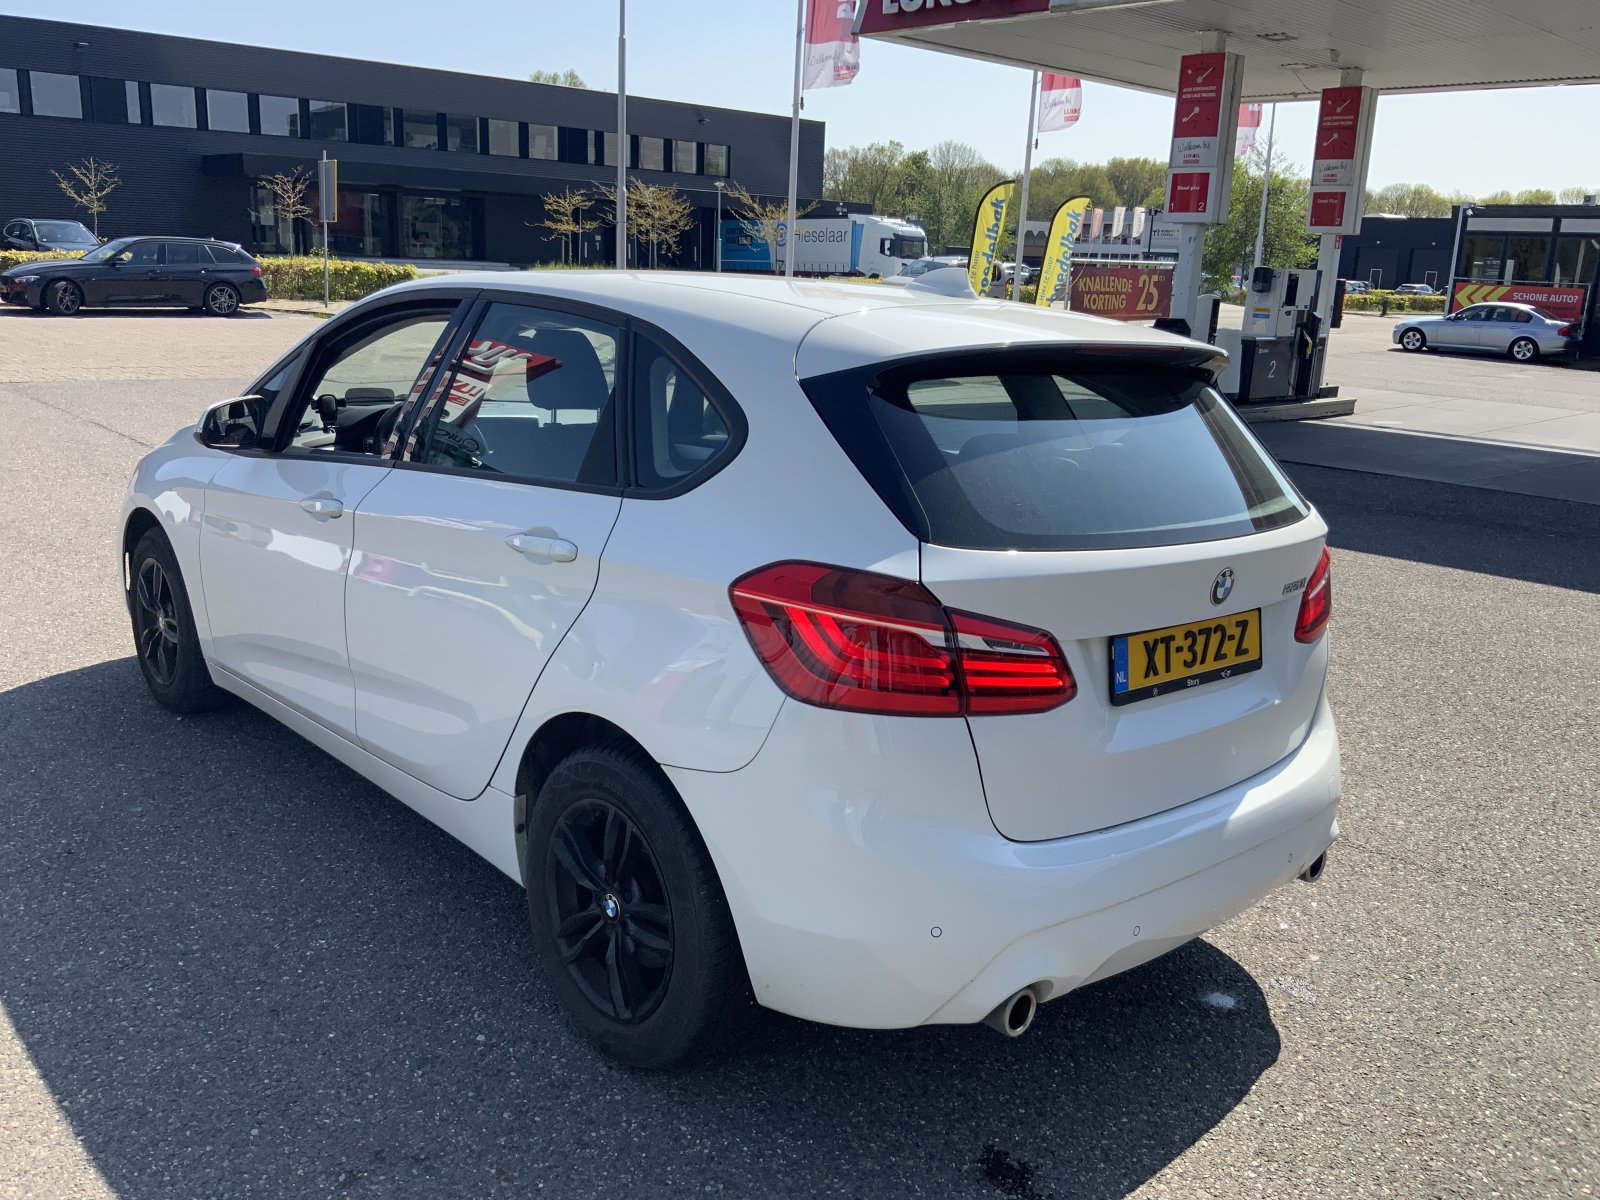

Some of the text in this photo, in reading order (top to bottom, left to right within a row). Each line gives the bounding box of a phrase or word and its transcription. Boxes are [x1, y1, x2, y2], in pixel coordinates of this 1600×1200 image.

[1170, 203, 1174, 211] 1
[1198, 202, 1205, 211] 2
[1335, 217, 1341, 225] 2
[1079, 276, 1133, 293] KNALLENDE
[1136, 274, 1159, 311] 25
[1512, 292, 1579, 303] SCHONE AUTO?
[1083, 294, 1127, 310] KORTING
[1267, 360, 1276, 379] 2
[1143, 619, 1250, 679] XT-372-Z
[1115, 670, 1127, 684] NL
[1186, 678, 1200, 687] Story
